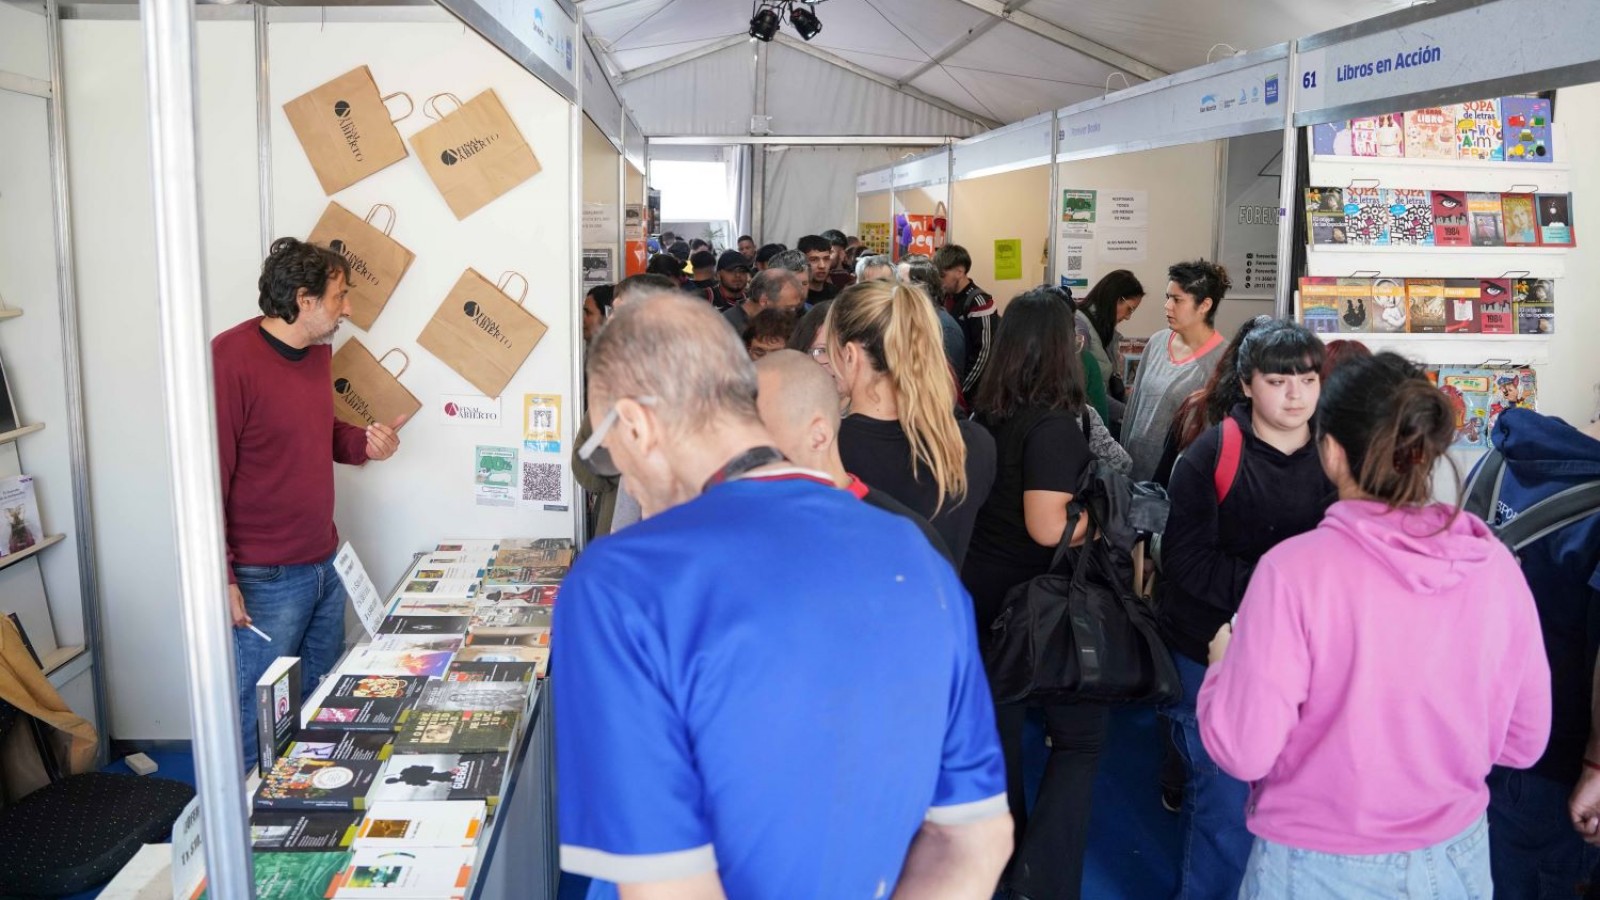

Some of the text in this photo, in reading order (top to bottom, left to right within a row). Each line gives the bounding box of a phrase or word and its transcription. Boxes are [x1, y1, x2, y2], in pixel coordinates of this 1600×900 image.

[1337, 46, 1441, 82] Libros en Acción
[1302, 70, 1317, 88] 61
[1463, 100, 1494, 112] SOPA
[1463, 110, 1495, 120] de letras
[338, 119, 363, 162] ABIERTO
[460, 133, 499, 162] ABIERTO
[1444, 226, 1460, 236] 1984
[1486, 314, 1503, 323] 1984
[473, 317, 512, 349] ABIERTO
[458, 411, 497, 420] ABIERTO
[452, 761, 471, 789] GUERRA
